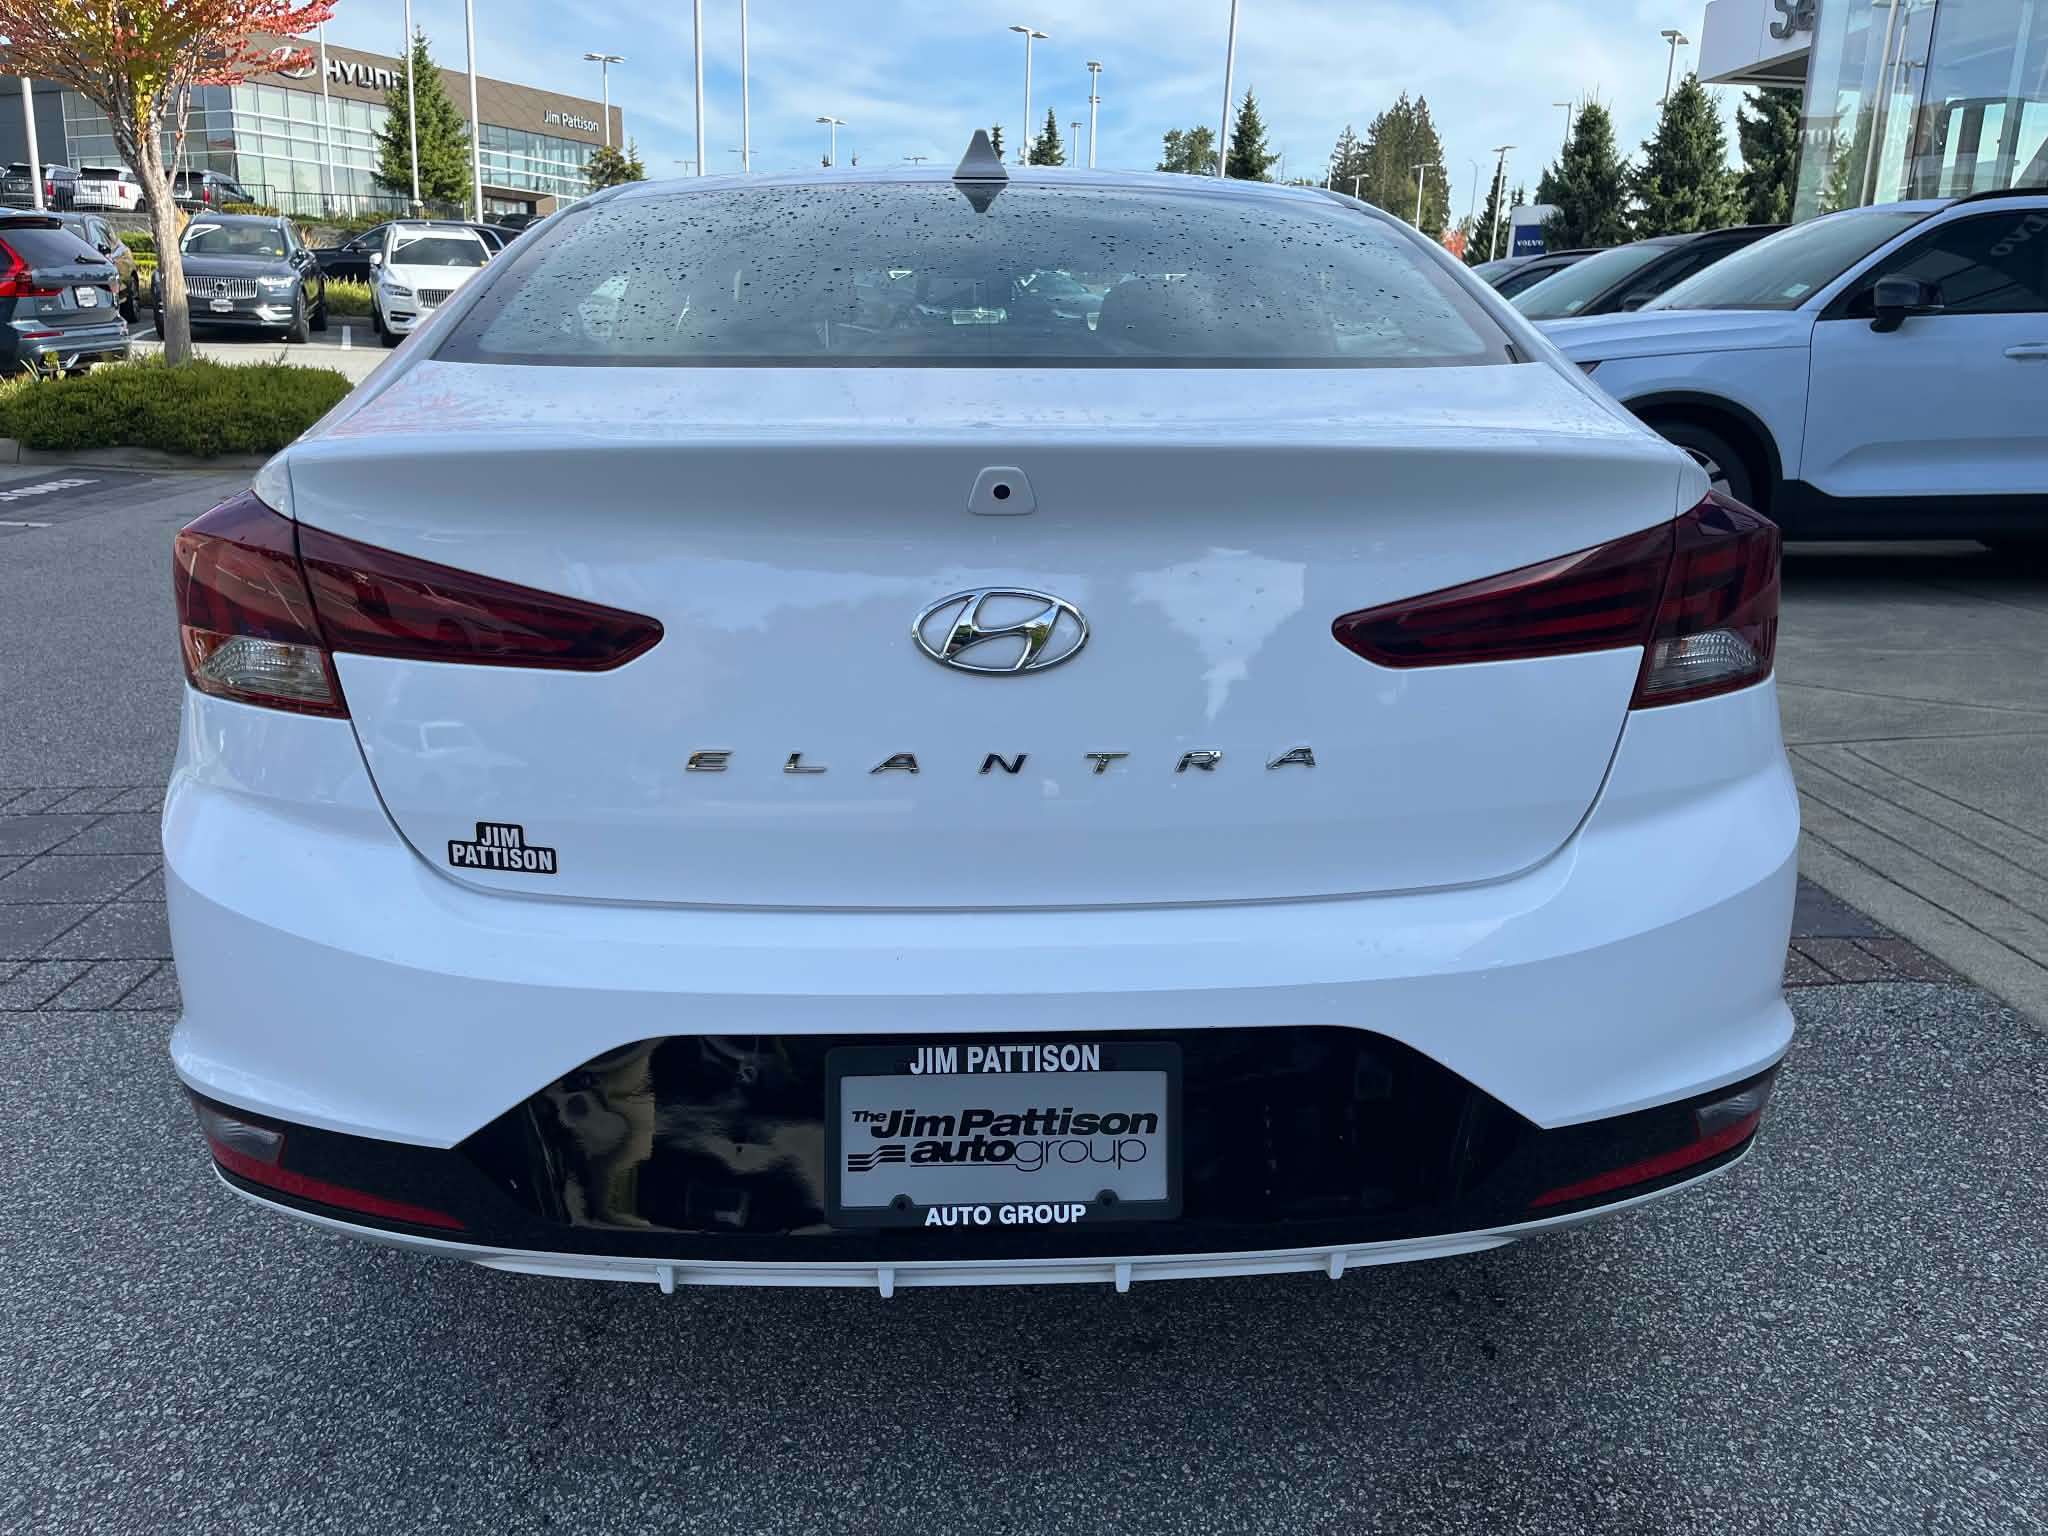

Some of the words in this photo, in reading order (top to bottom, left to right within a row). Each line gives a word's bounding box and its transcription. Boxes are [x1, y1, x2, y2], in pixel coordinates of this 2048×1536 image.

[544, 110, 560, 124] Jim
[562, 113, 599, 132] Pattison
[1517, 239, 1544, 247] VOLVO
[686, 747, 1317, 775] ELANTRA
[481, 826, 520, 848] JIM
[452, 843, 553, 871] PATTISON
[910, 1047, 957, 1075] JIM
[967, 1044, 1100, 1073] PATTISON
[852, 1110, 887, 1123] The
[871, 1108, 956, 1138] Jim
[958, 1107, 1158, 1137] Pattison
[924, 1206, 992, 1226] AUTO
[999, 1204, 1086, 1225] GROUP
